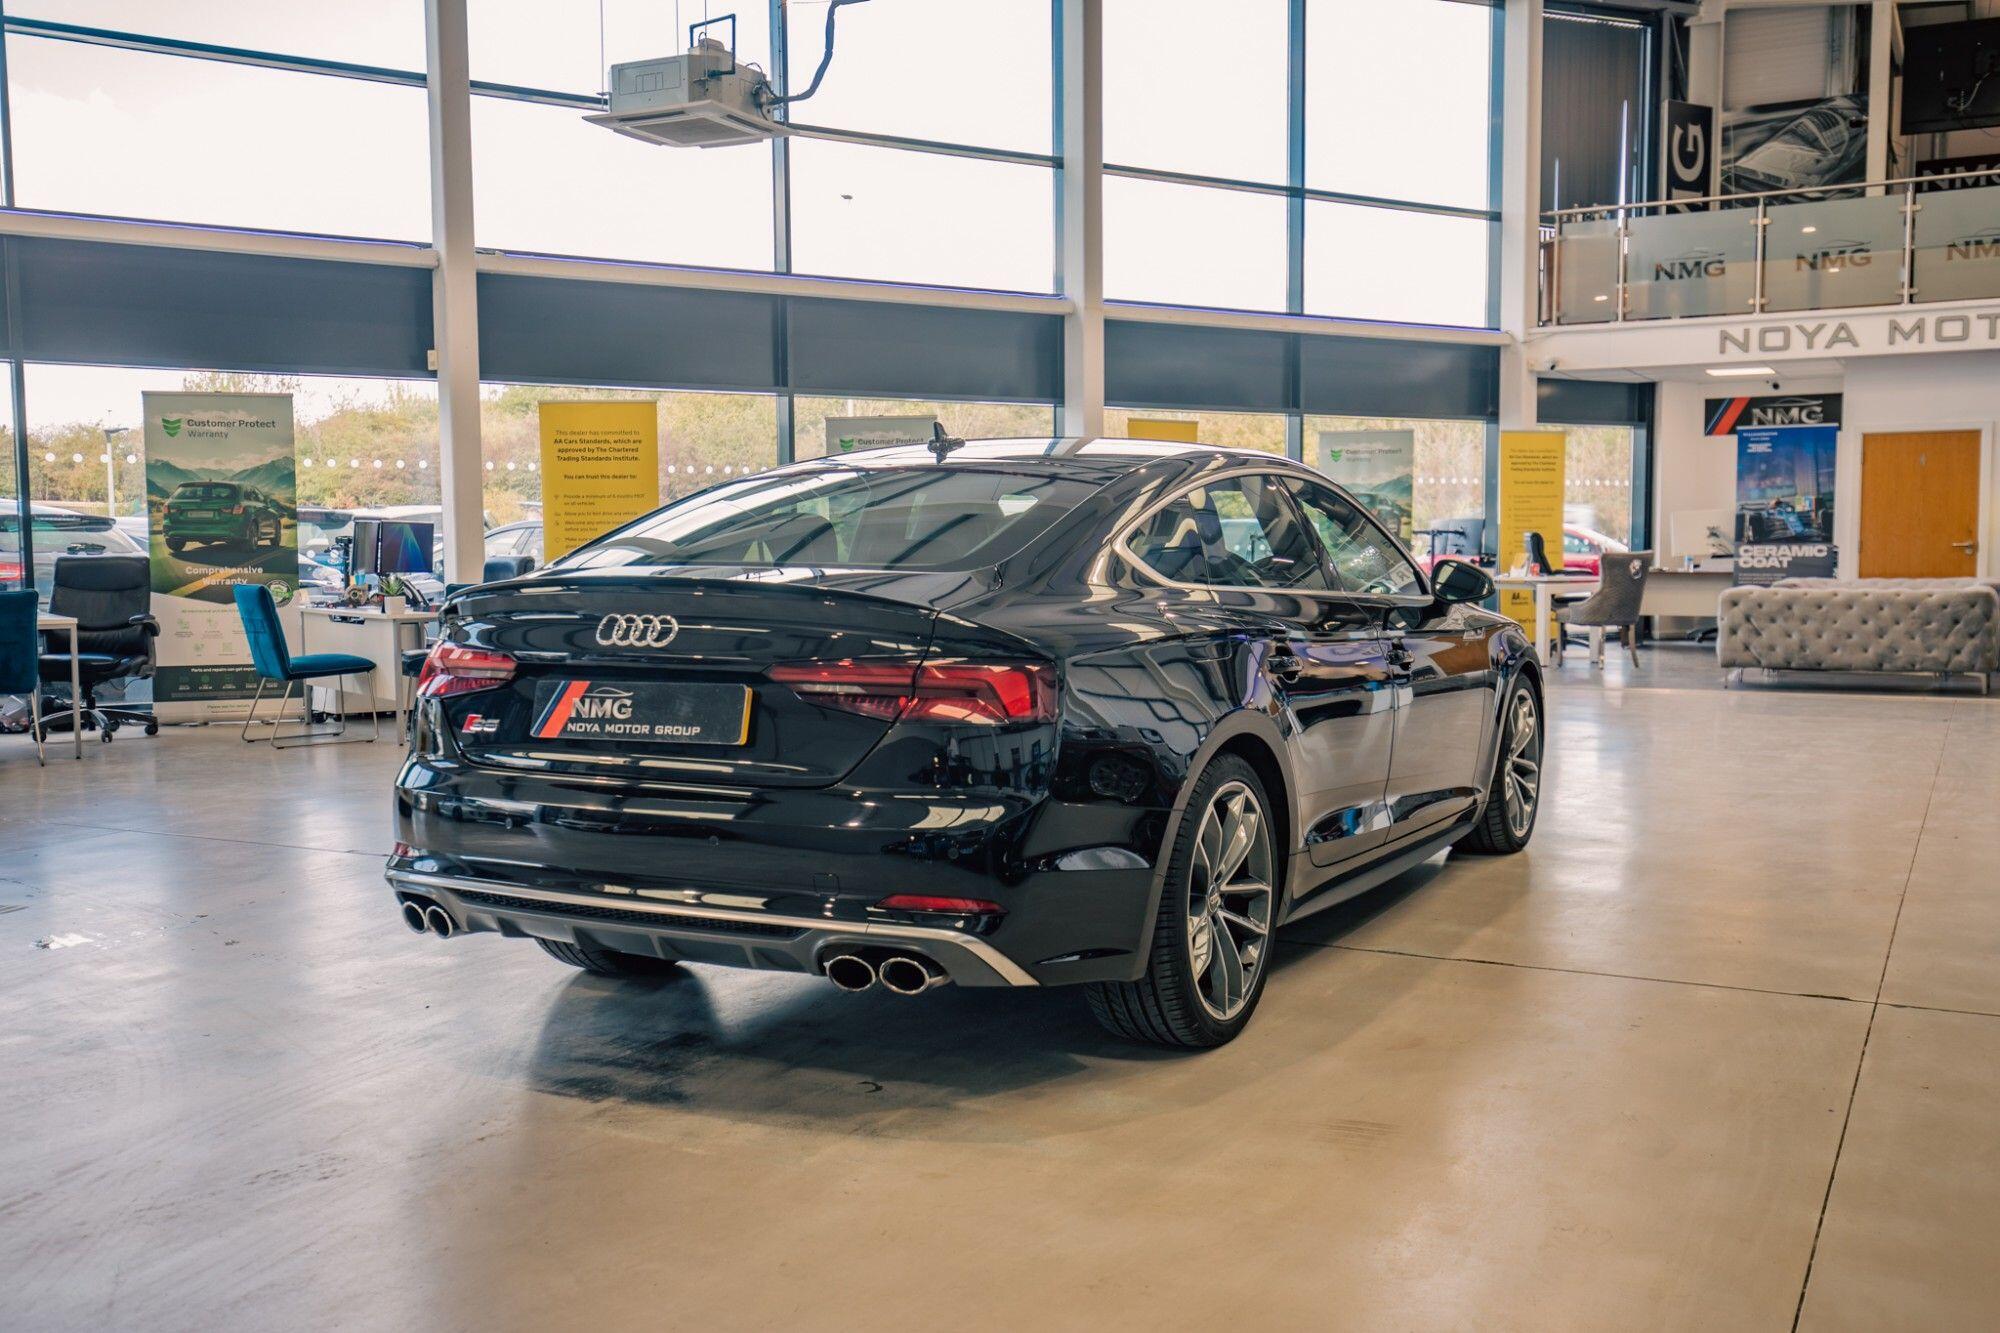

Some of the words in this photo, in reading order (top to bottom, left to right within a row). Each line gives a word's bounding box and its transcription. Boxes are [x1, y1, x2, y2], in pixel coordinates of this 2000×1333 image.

[1795, 248, 1872, 272] NMG
[1654, 259, 1726, 281] NMG
[1718, 322, 1860, 355] NOYA
[1888, 313, 2000, 346] MOT
[1752, 406, 1824, 426] NMG
[186, 418, 236, 428] Customer
[238, 419, 276, 429] Protect
[187, 430, 229, 440] Warranty
[1738, 544, 1828, 557] CERAMIC
[1738, 557, 1793, 568] COAT
[185, 565, 263, 576] Comprehensive
[202, 577, 248, 585] Warranty
[569, 697, 633, 720] NMG
[566, 722, 601, 733] NOYA
[604, 723, 651, 734] MOTOR
[654, 725, 701, 736] GROUP
